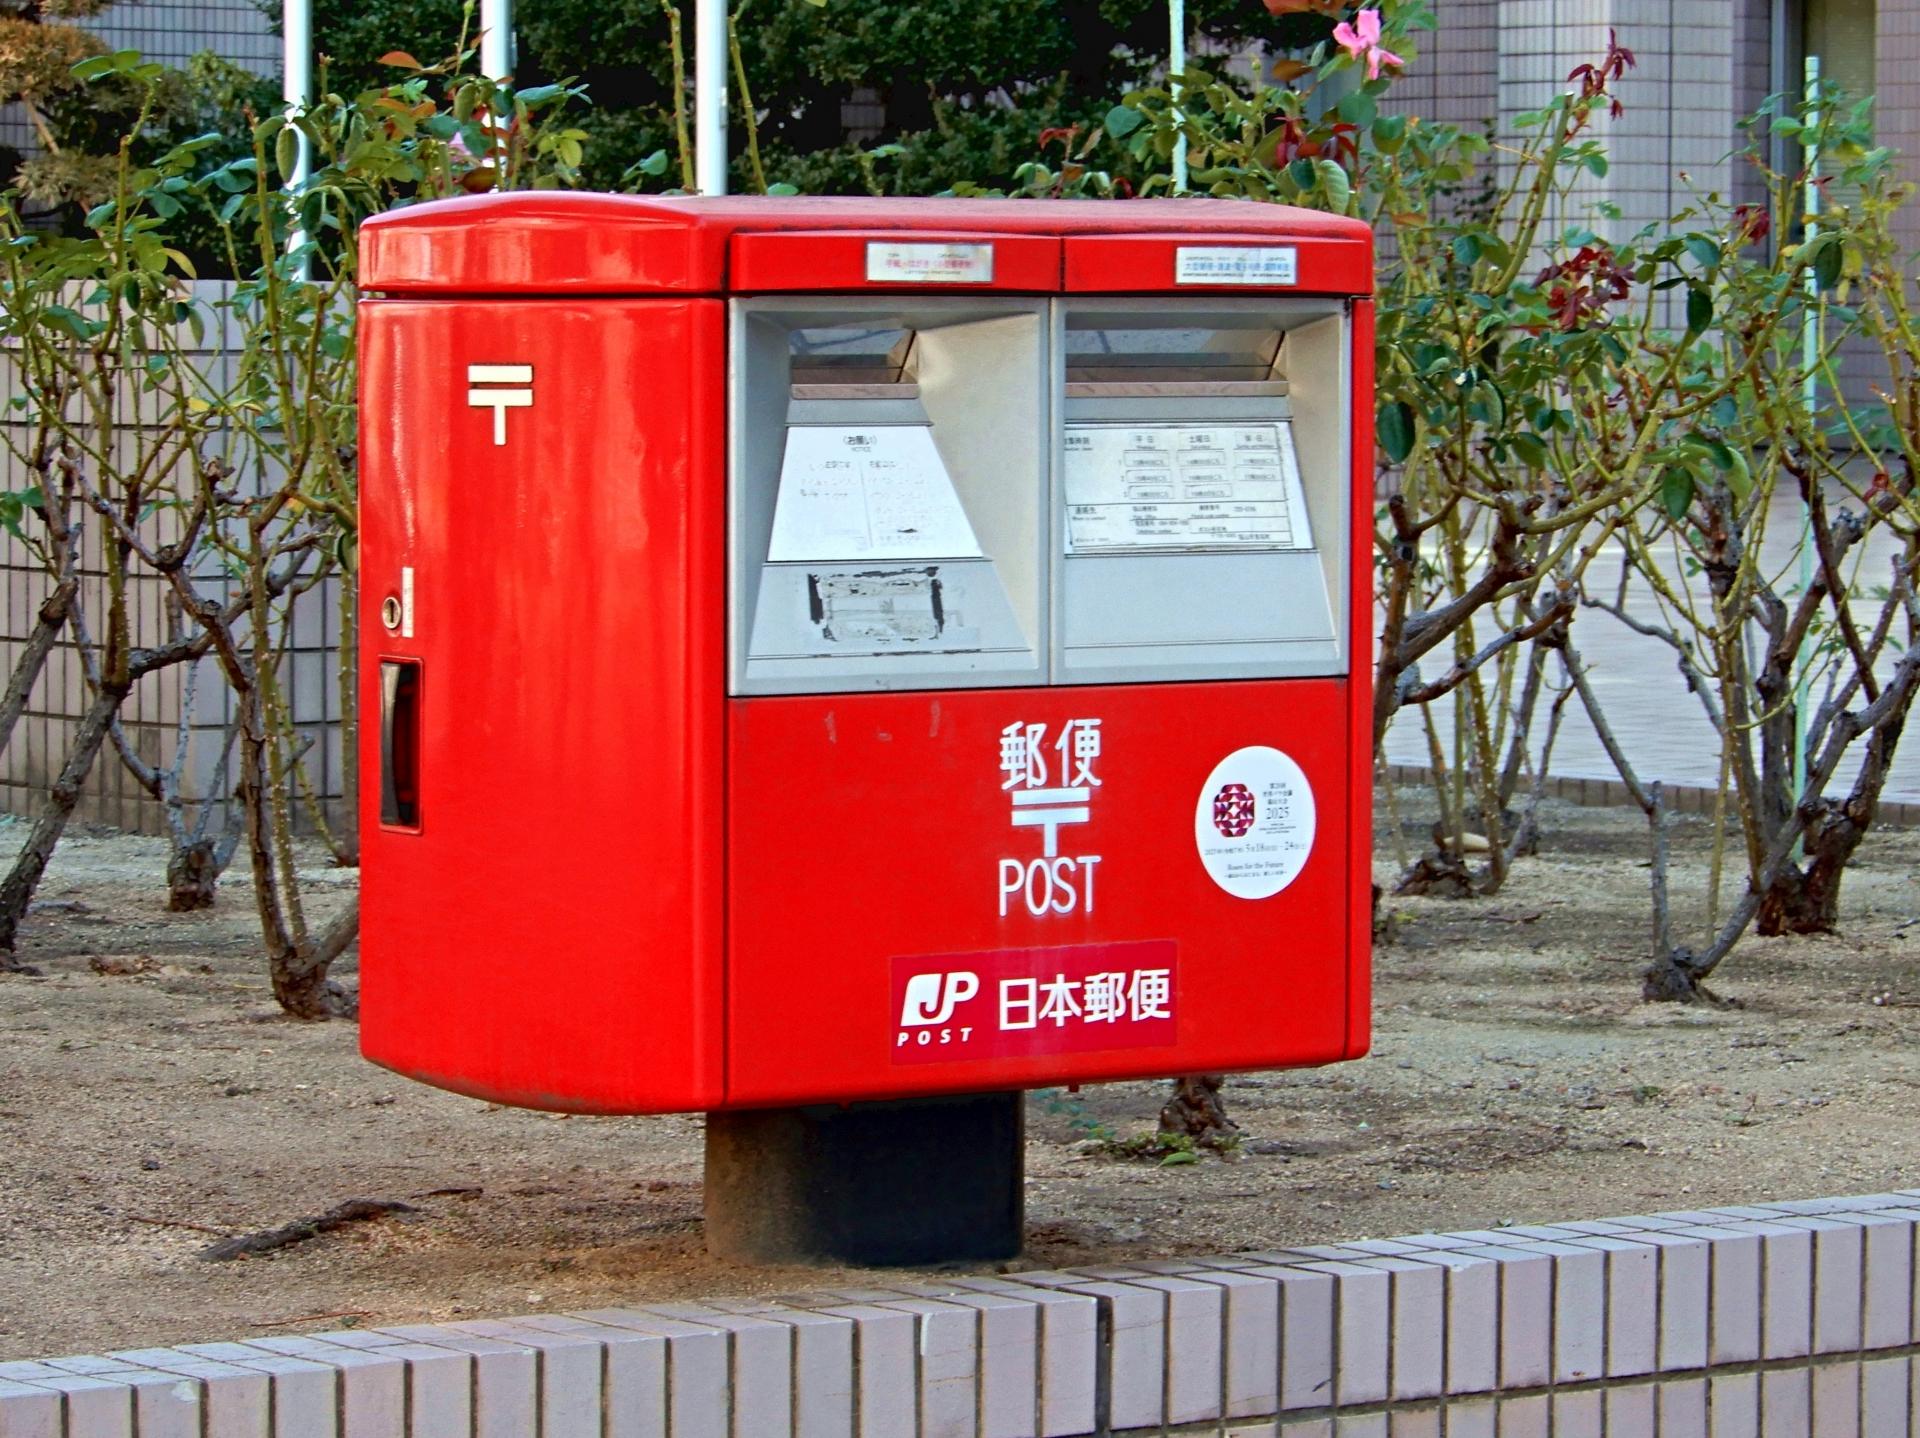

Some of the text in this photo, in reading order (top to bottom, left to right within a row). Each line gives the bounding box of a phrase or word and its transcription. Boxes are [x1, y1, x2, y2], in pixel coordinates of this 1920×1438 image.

[999, 718, 1102, 790] 郵便
[1266, 806, 1290, 820] 2025
[998, 857, 1102, 917] POST
[998, 968, 1171, 1031] 日本郵便
[898, 1028, 974, 1049] POST
